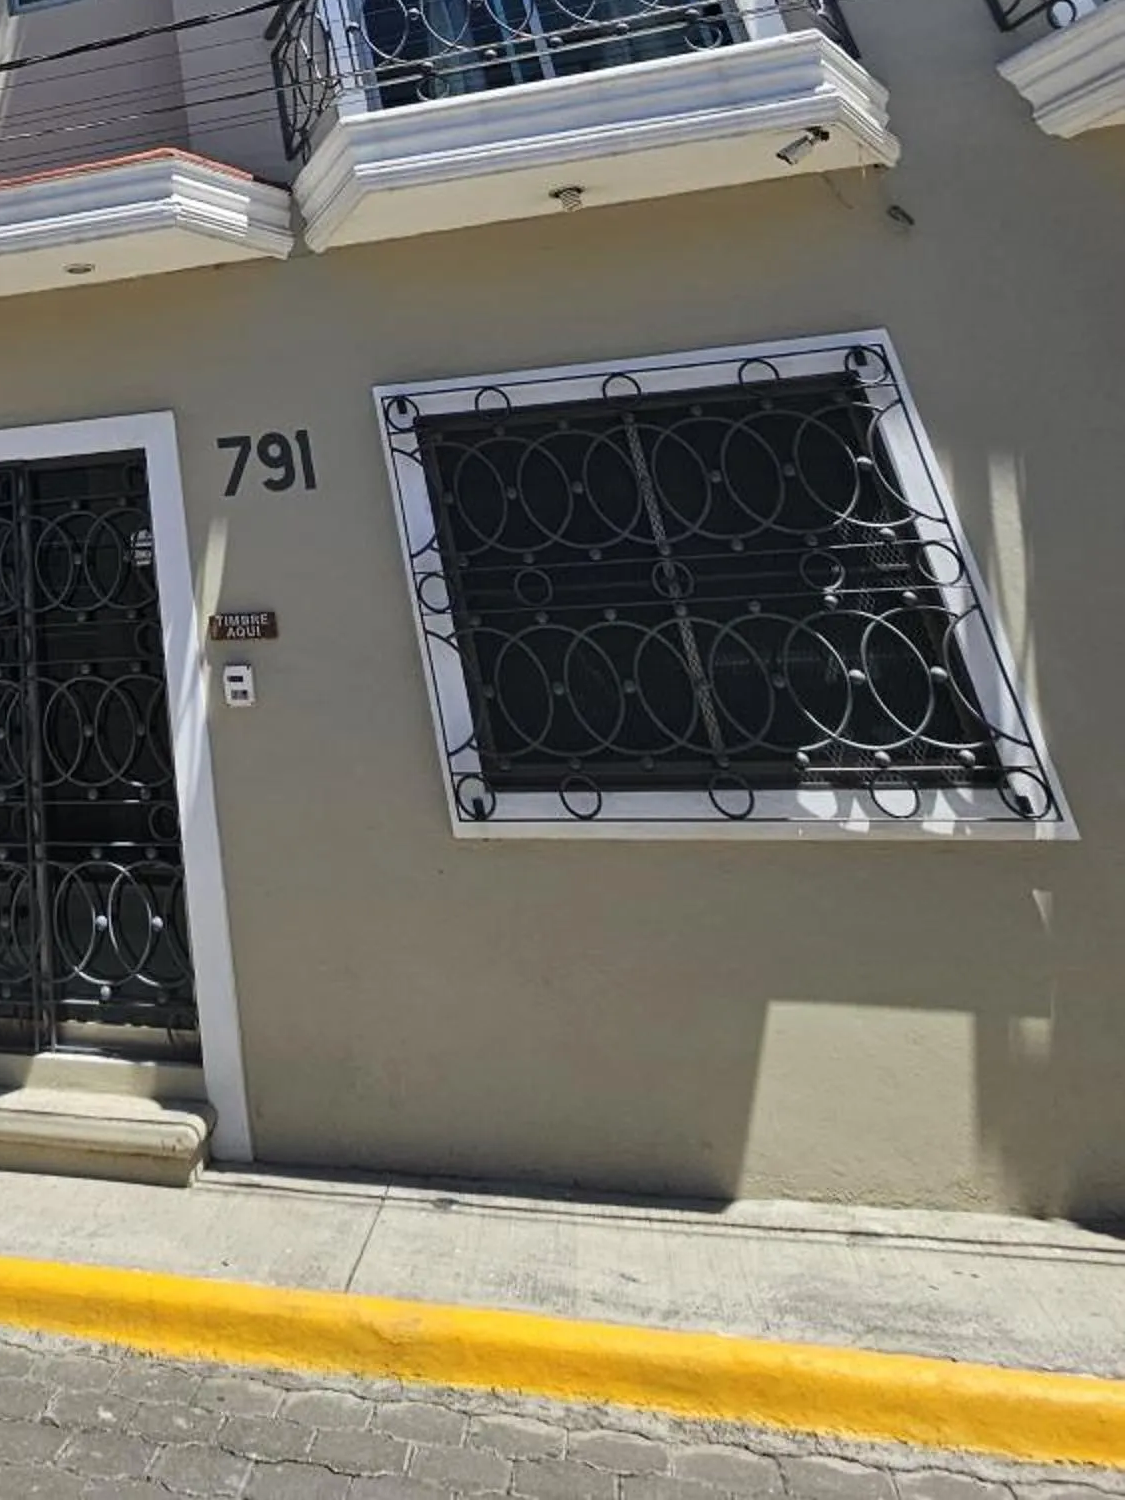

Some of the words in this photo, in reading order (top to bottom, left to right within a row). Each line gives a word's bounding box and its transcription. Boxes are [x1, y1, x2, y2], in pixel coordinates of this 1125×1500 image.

[216, 429, 317, 497] 791
[215, 613, 269, 627] TIMBRE
[227, 625, 262, 638] AQUI
